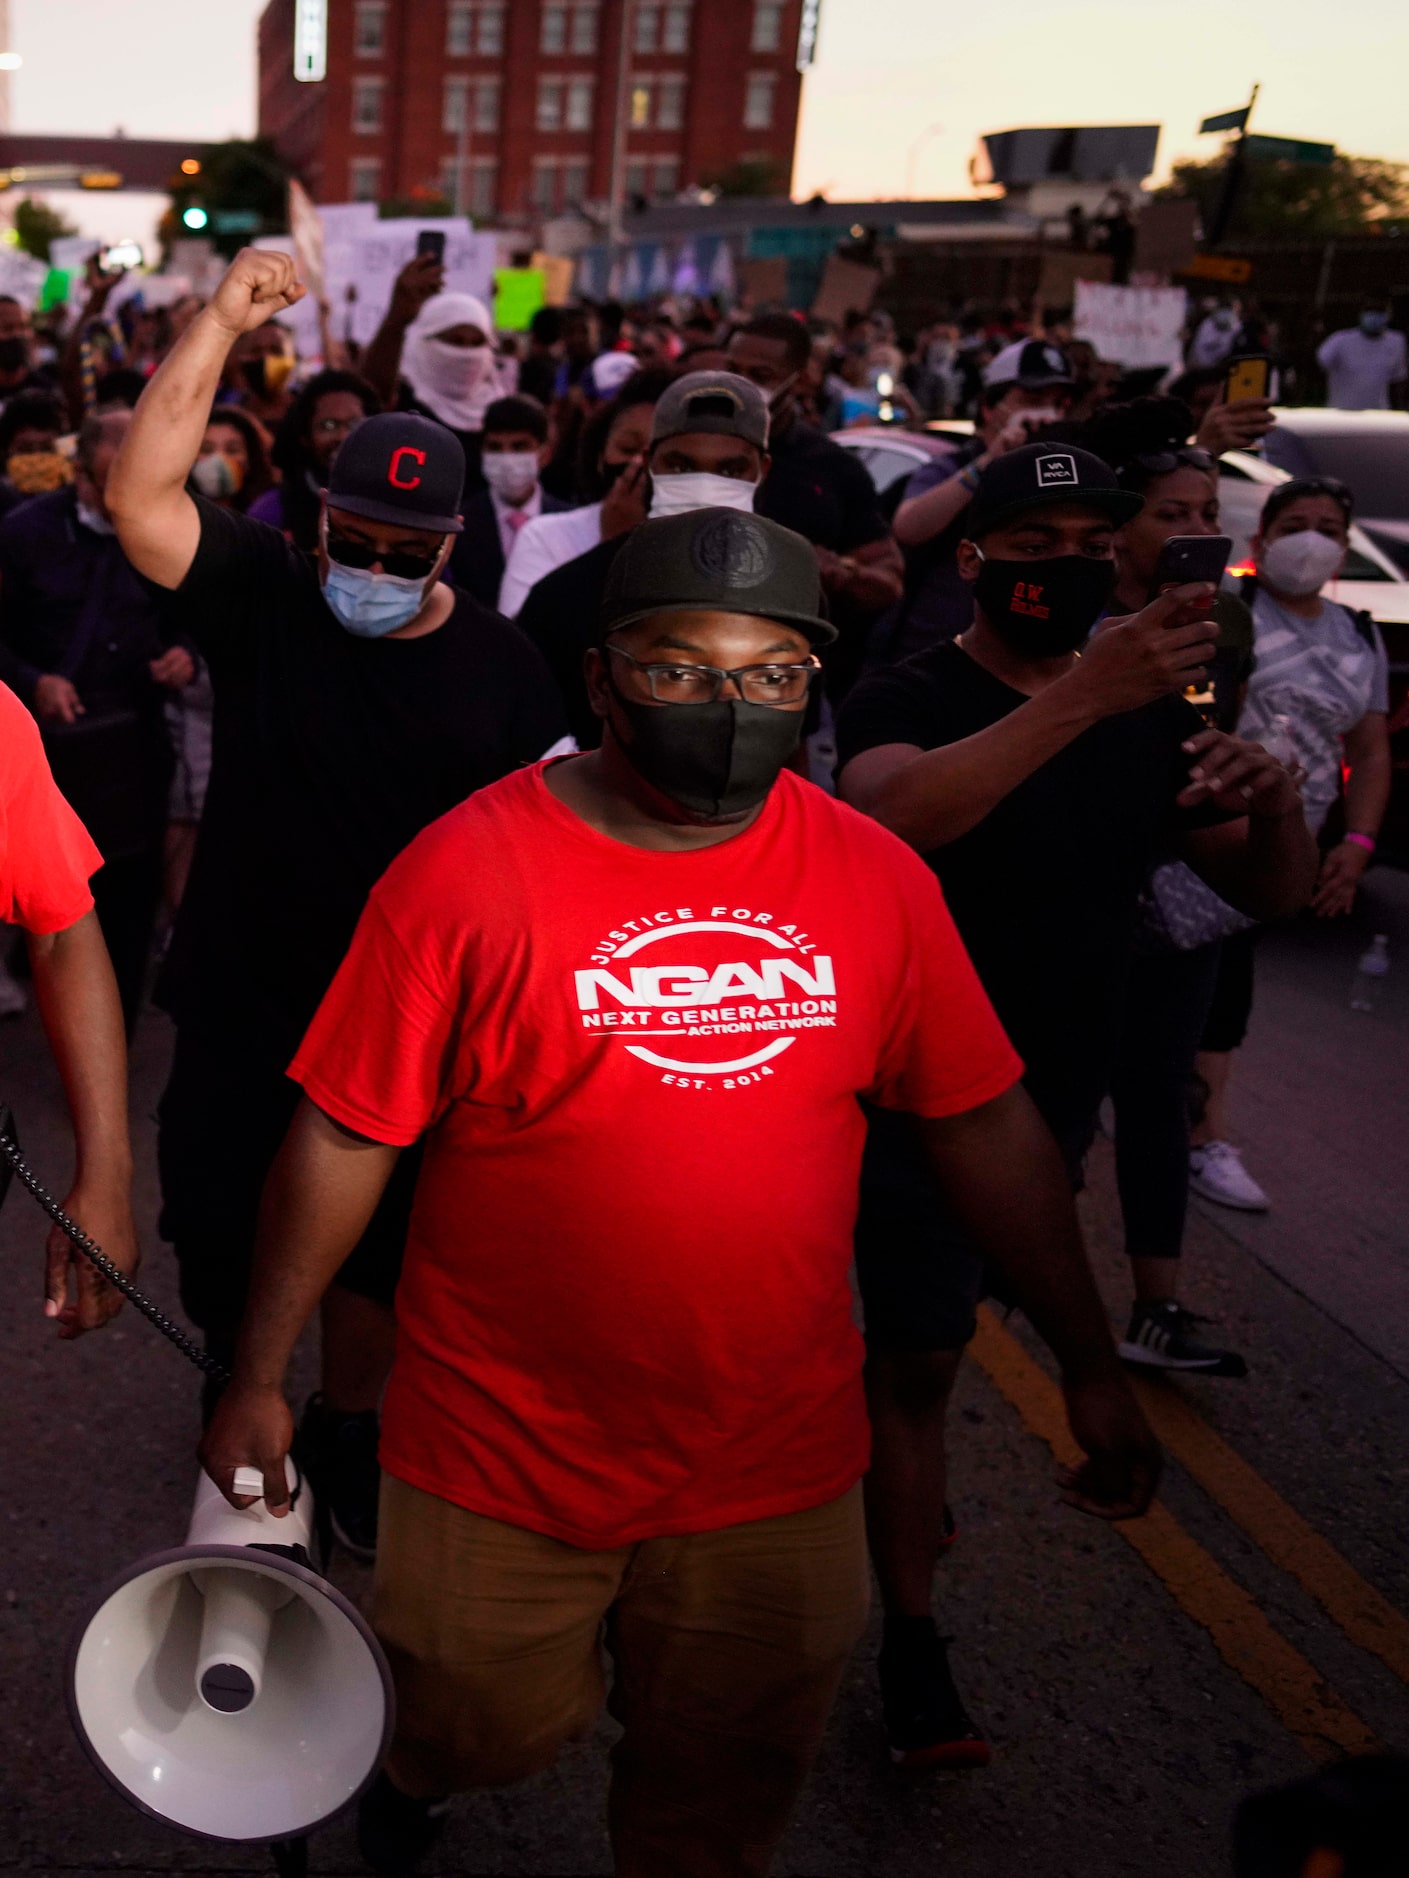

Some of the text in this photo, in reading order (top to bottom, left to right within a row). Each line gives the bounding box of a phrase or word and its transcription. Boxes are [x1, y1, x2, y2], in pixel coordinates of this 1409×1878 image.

[388, 446, 427, 490] C
[591, 906, 817, 964] JUSTICE FOR ALL
[574, 955, 837, 1010] NGAN
[581, 1000, 837, 1028] NEXT GENERATION
[687, 1016, 837, 1036] ACTION NETWORK
[661, 1065, 775, 1091] EST. 2014
